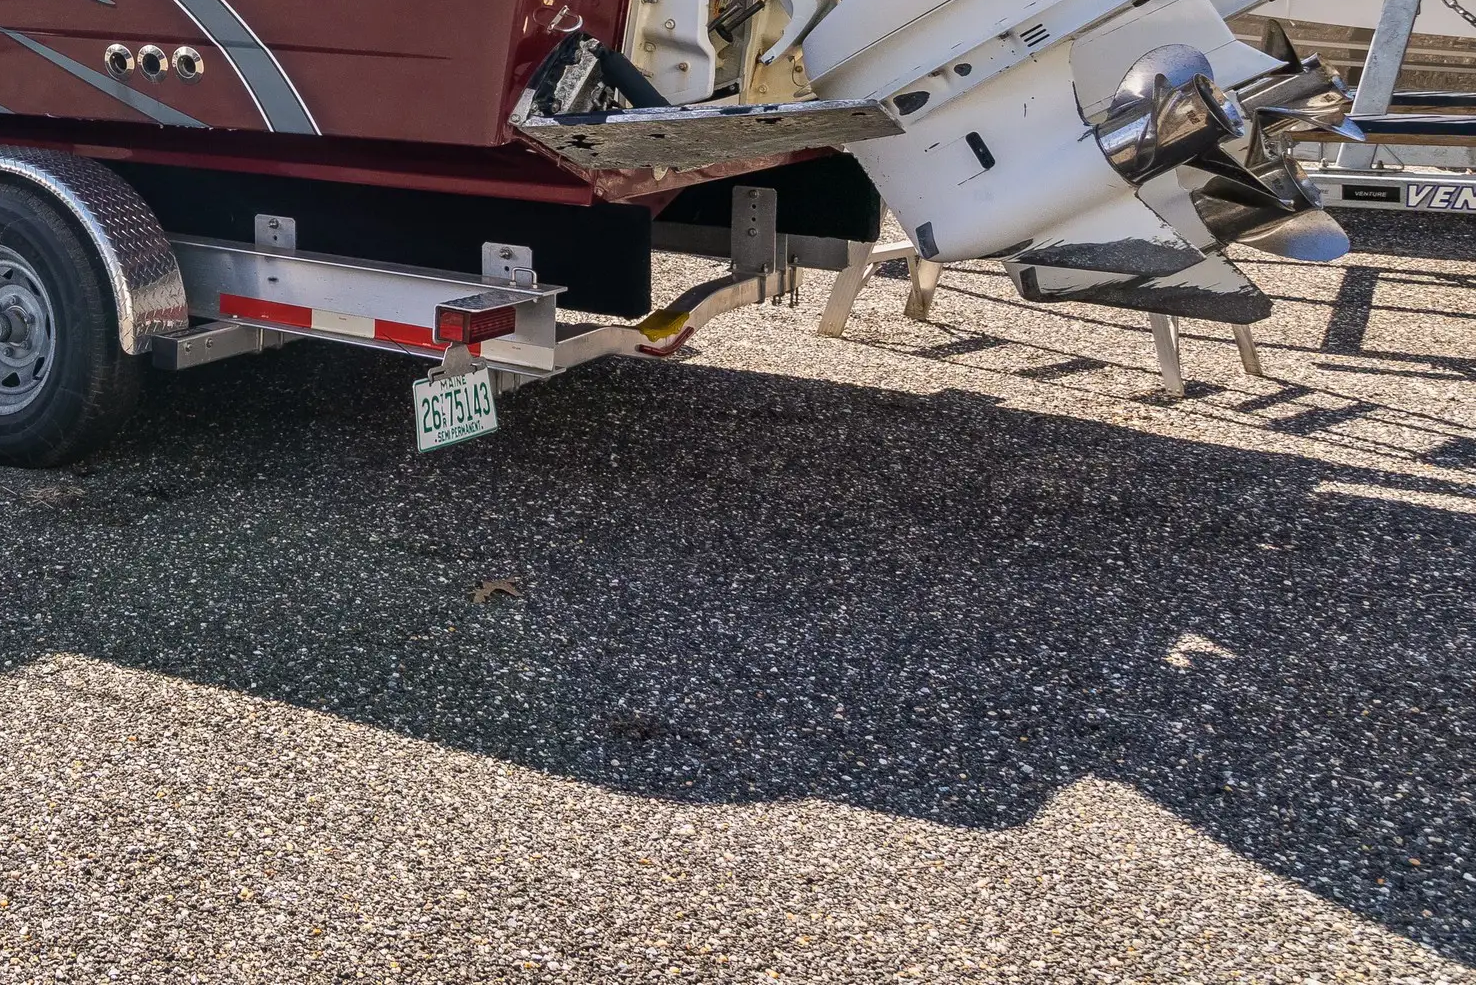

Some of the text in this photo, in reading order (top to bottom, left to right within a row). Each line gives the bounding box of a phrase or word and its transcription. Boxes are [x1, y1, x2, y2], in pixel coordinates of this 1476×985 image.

[1354, 190, 1388, 198] VENTURE
[1405, 183, 1476, 210] VEN
[439, 375, 467, 391] MAINE
